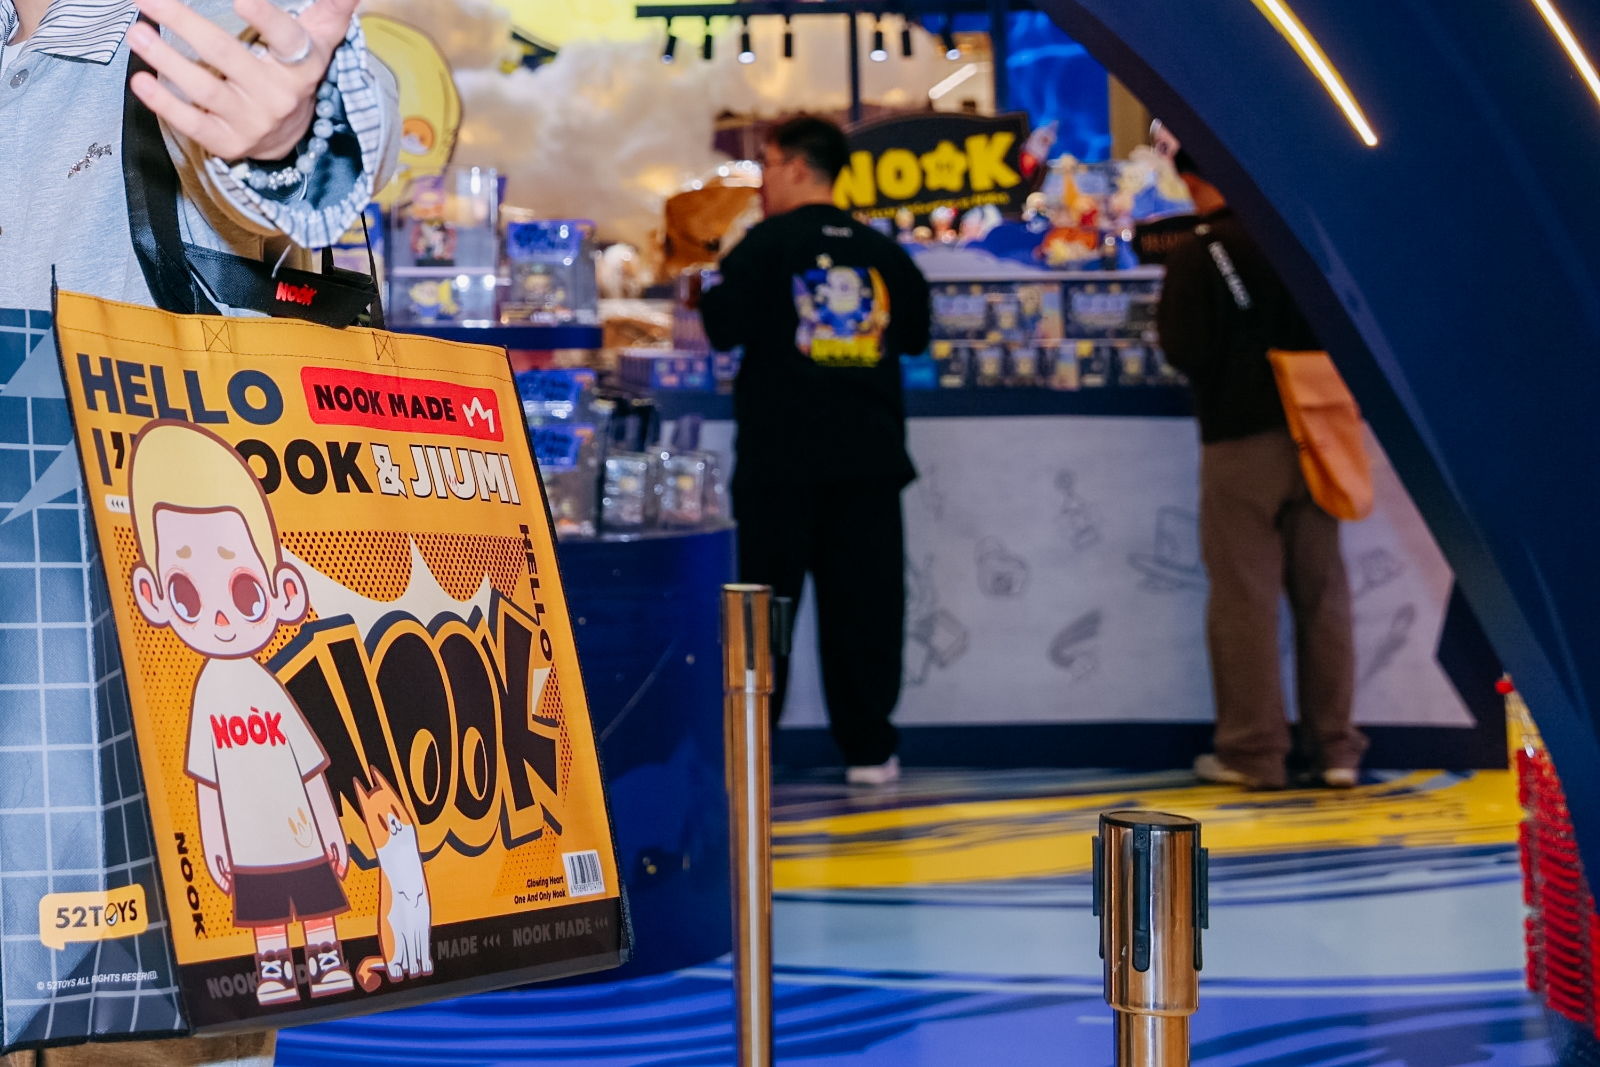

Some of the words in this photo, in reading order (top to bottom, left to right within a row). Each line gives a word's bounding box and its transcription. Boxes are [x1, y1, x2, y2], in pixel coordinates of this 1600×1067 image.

[76, 352, 284, 426] HELLO
[312, 384, 386, 418] NOOK
[388, 393, 457, 422] MADE
[234, 438, 373, 495] OOK
[408, 443, 522, 506] JIUMI
[518, 524, 553, 662] HELLO
[280, 601, 560, 829] NOOK
[174, 831, 208, 940] NOOK
[514, 894, 526, 904] One
[527, 892, 538, 902] And
[539, 891, 551, 901] Only
[552, 888, 566, 899] Nook
[526, 876, 549, 888] Glowing
[549, 875, 564, 885] Heart
[55, 899, 138, 929] 52TOYS
[437, 935, 478, 961] MADE
[512, 923, 551, 947] NOOK
[554, 917, 593, 939] MADE
[46, 978, 77, 990] 52TOYS
[77, 976, 91, 986] ALL
[91, 972, 120, 984] RIGHTS
